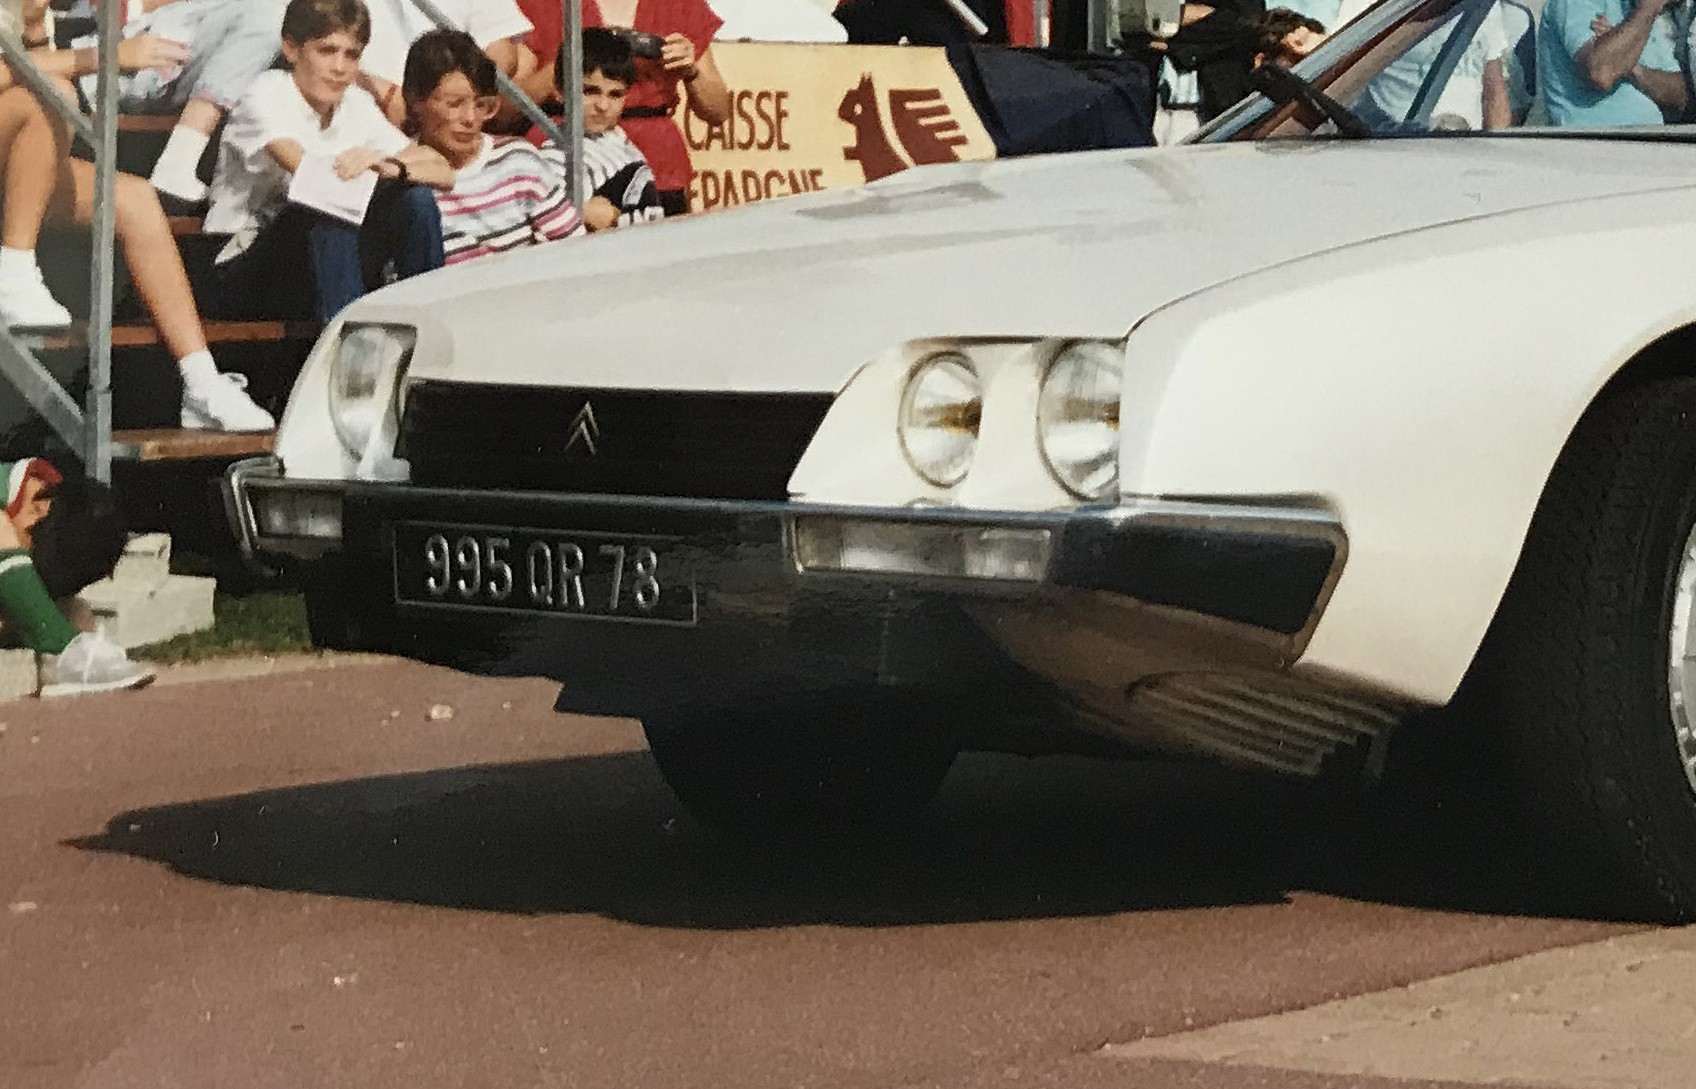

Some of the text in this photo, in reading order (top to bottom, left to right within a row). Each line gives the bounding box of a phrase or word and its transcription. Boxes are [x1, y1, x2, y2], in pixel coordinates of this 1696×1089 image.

[424, 533, 660, 609] 995 QR 78
